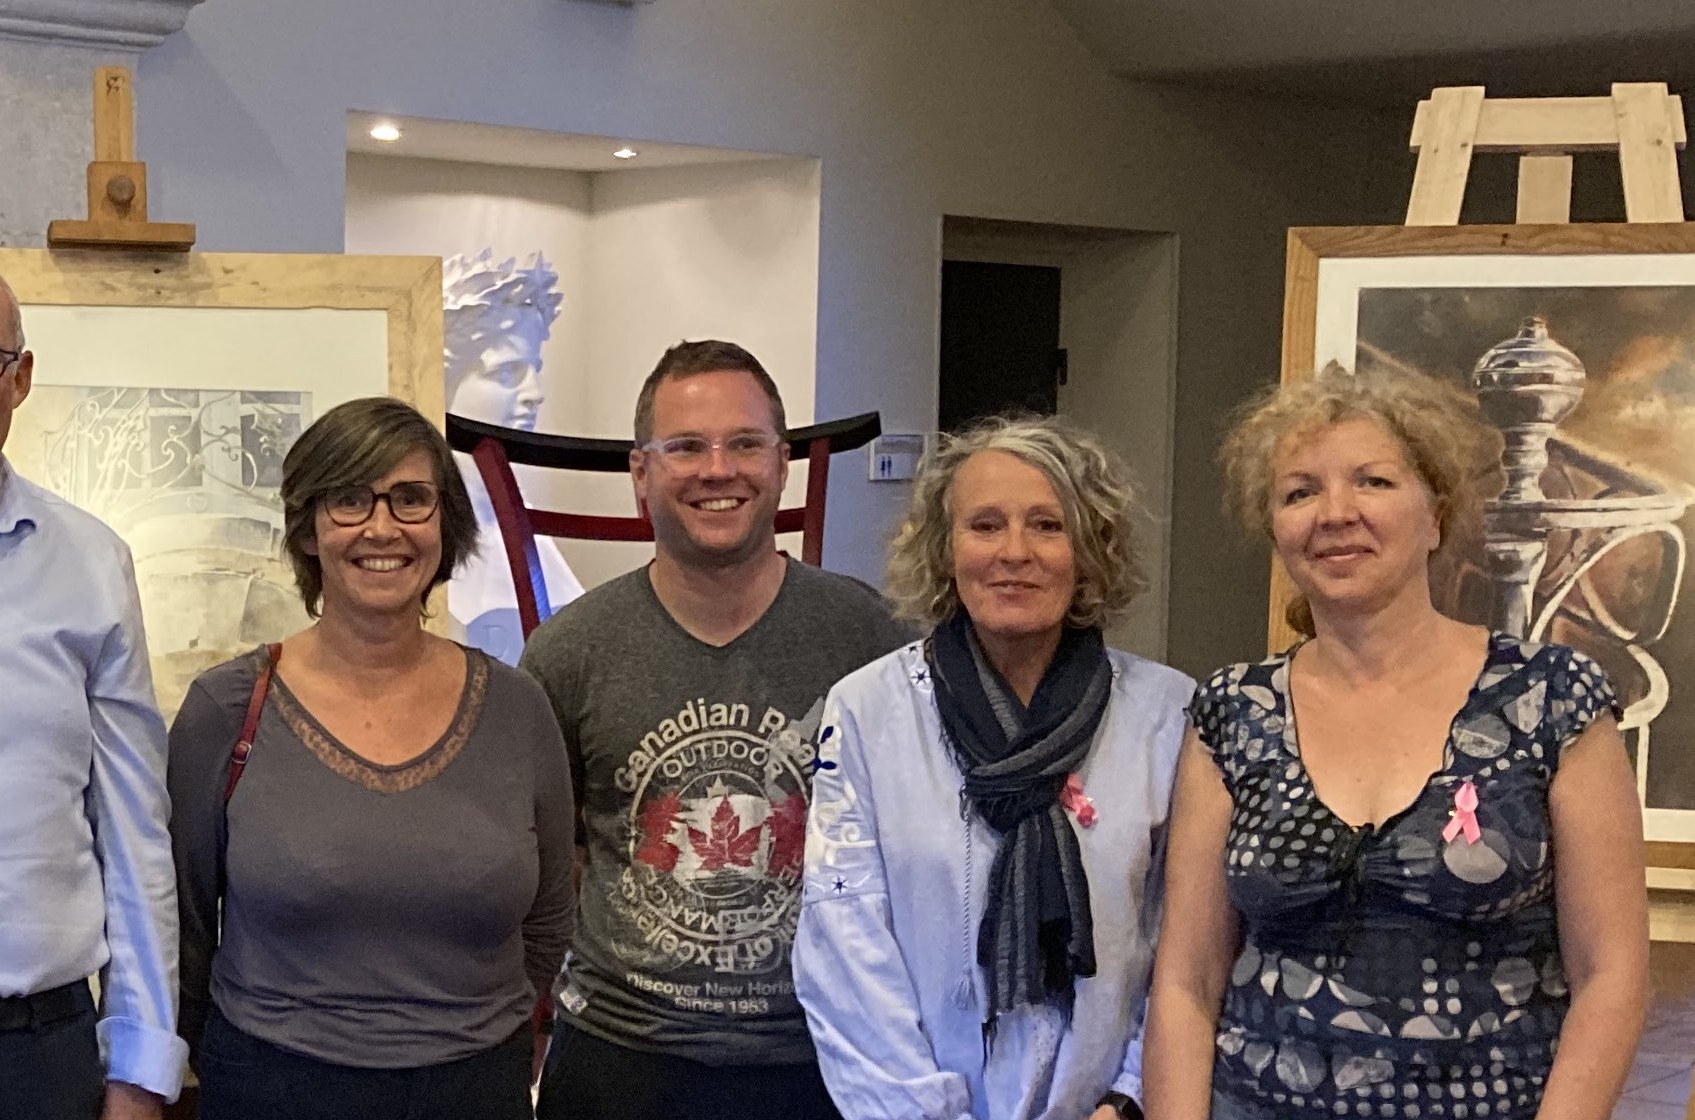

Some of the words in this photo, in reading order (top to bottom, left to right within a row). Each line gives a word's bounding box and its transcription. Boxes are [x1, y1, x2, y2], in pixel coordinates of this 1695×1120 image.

[613, 697, 749, 793] Canadian
[662, 738, 784, 784] OUTDOOR
[706, 982, 744, 997] New
[748, 980, 796, 996] Horiz
[673, 996, 725, 1013] Since
